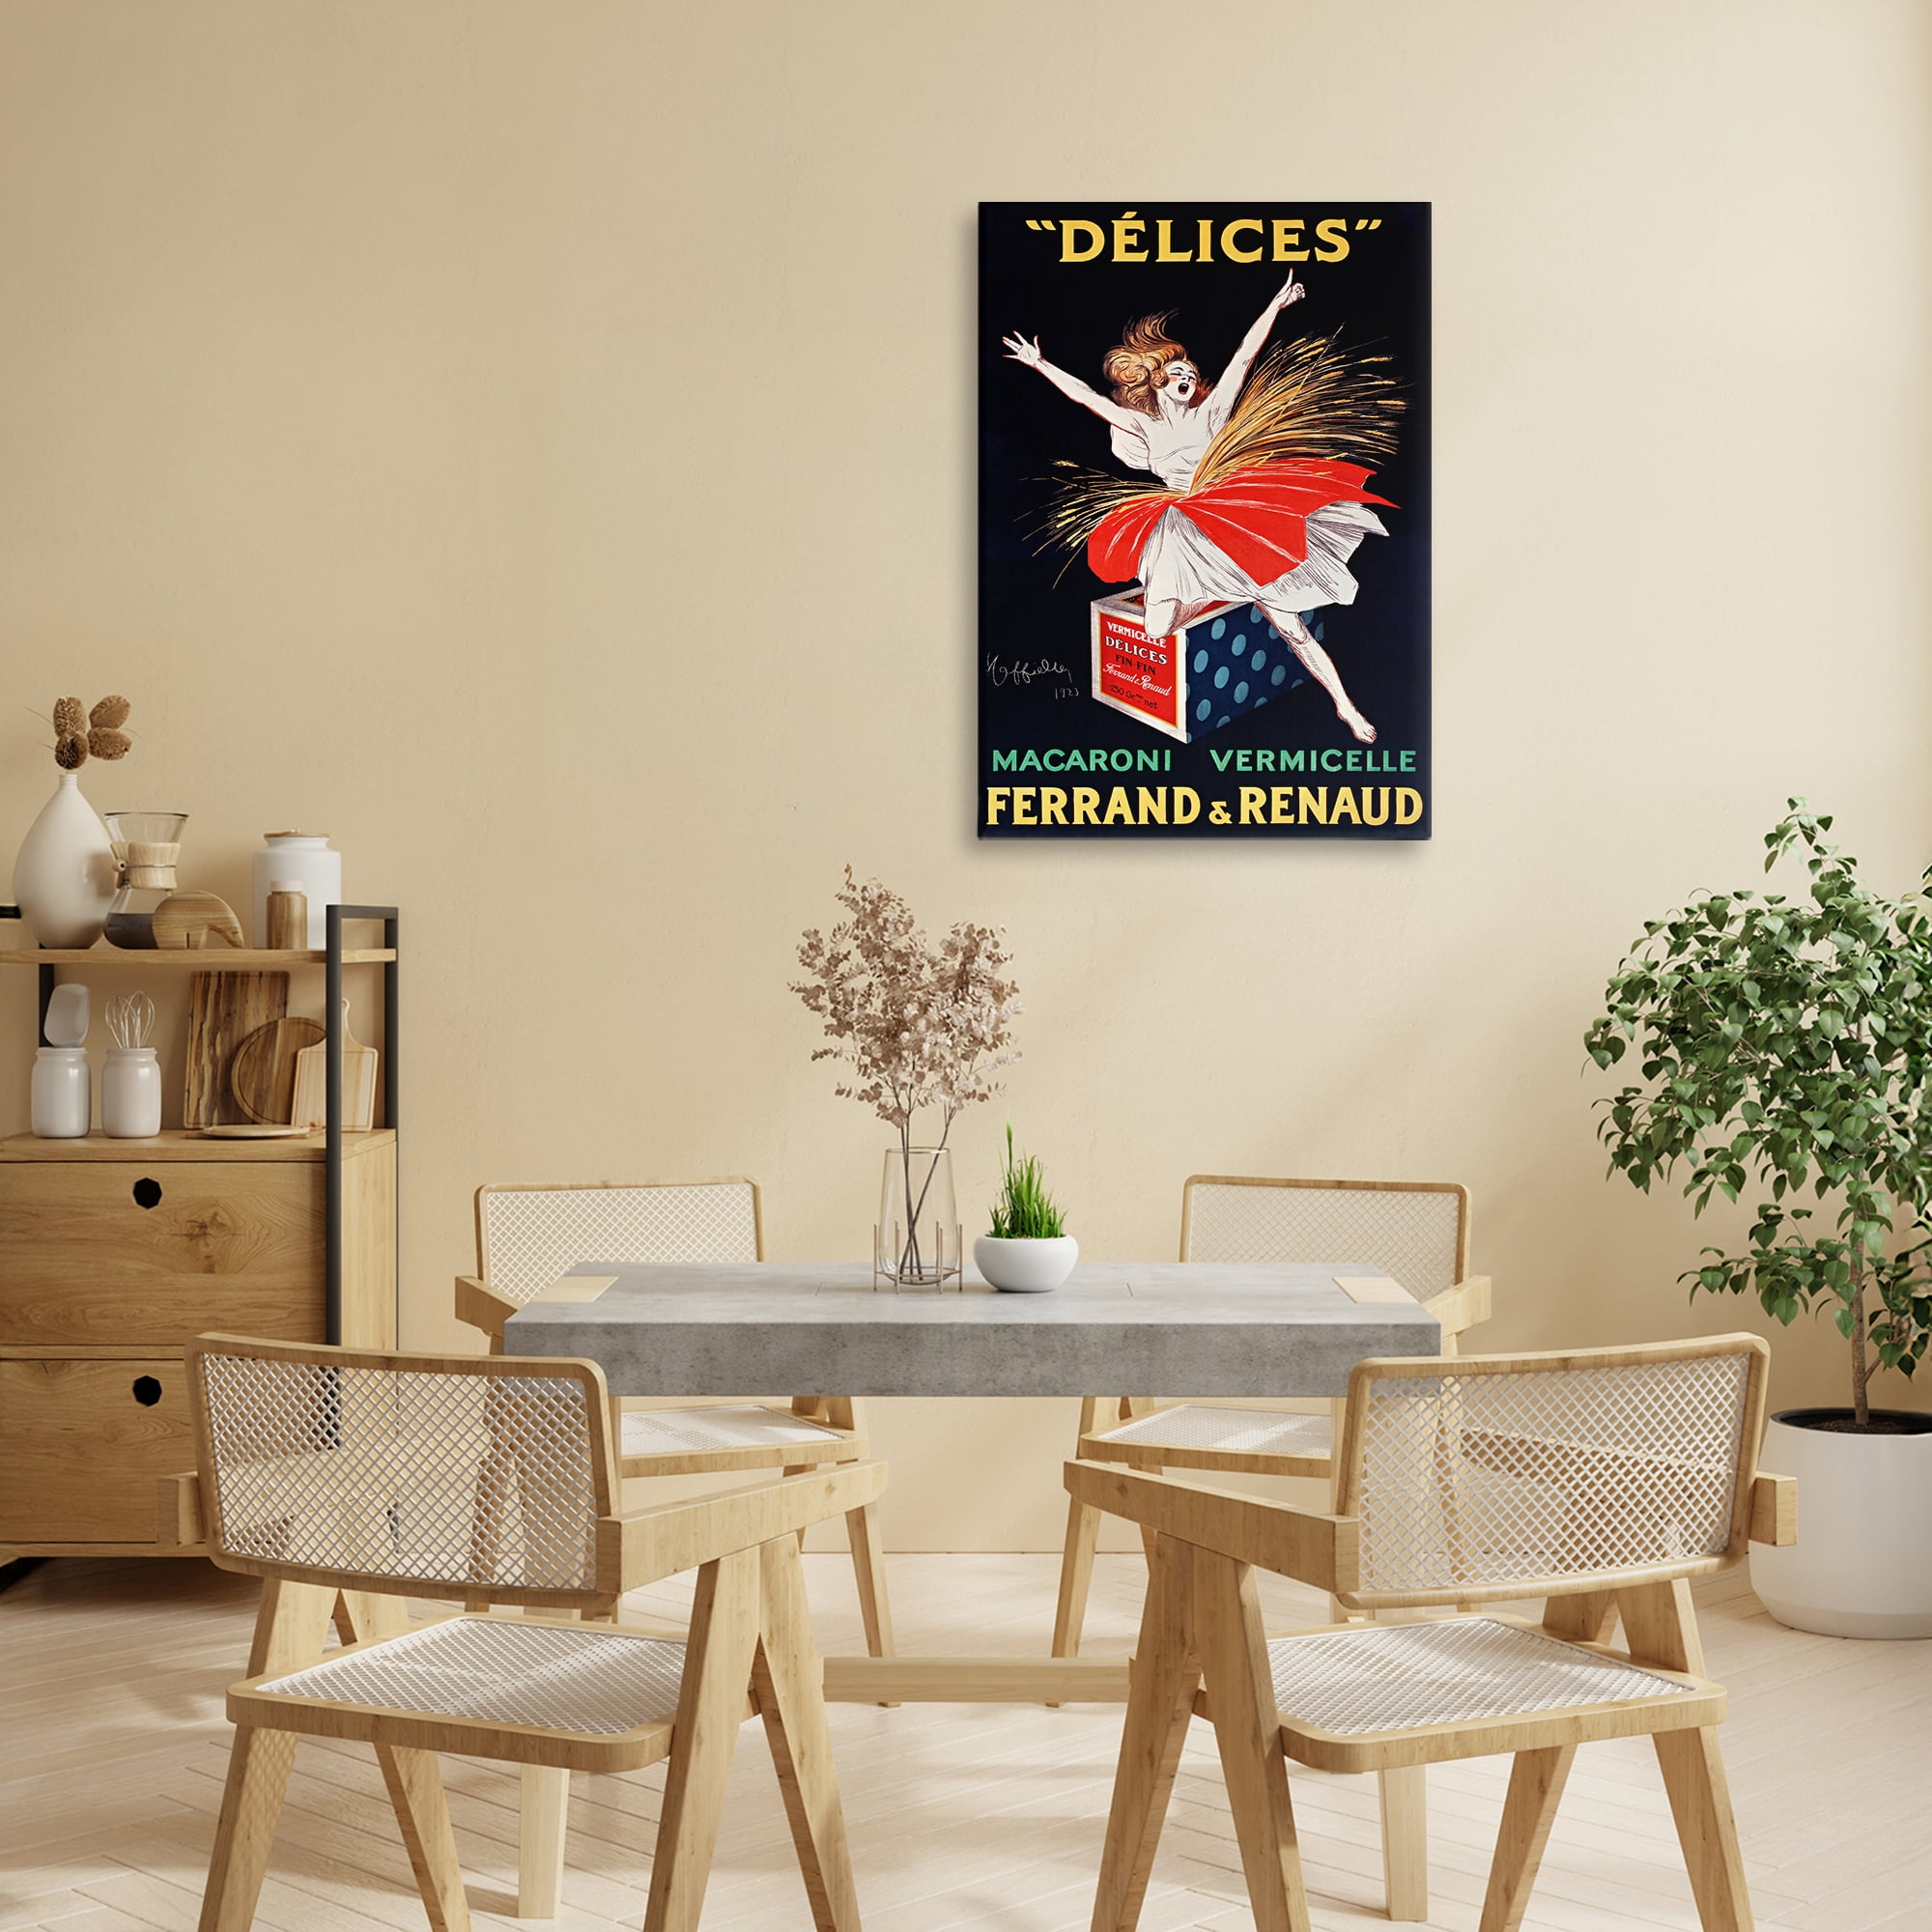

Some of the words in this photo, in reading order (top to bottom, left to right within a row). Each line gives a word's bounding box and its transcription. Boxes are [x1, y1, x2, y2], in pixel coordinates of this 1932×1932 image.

[1138, 674, 1173, 696] Renaud
[992, 749, 1171, 773] MACARONI
[1208, 749, 1417, 773] VERMICELLE
[985, 787, 1201, 826] FERRAND
[1208, 801, 1233, 825] &
[1237, 787, 1424, 826] RENAUD
